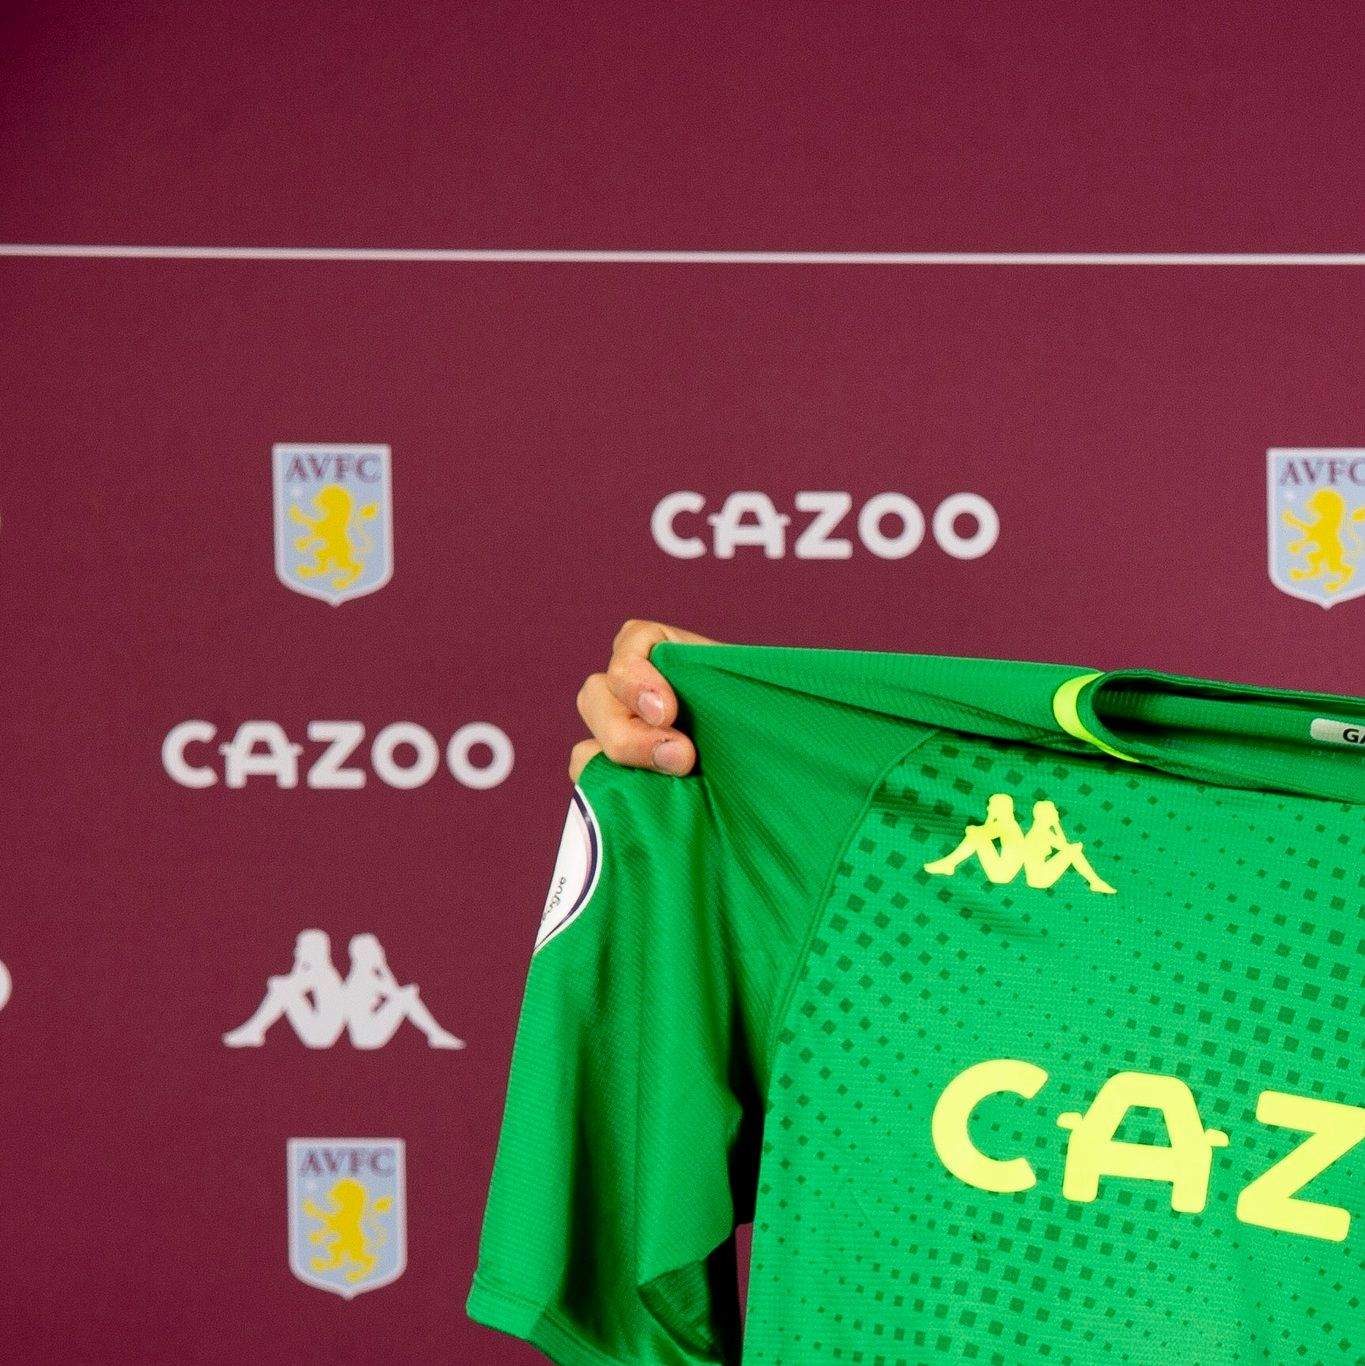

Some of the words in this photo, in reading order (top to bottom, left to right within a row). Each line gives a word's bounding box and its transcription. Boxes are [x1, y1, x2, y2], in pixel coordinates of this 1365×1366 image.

[285, 454, 382, 483] AVFC
[651, 491, 1000, 560] CAZOO
[161, 721, 514, 790] CAZOO
[301, 1147, 396, 1177] AVFC
